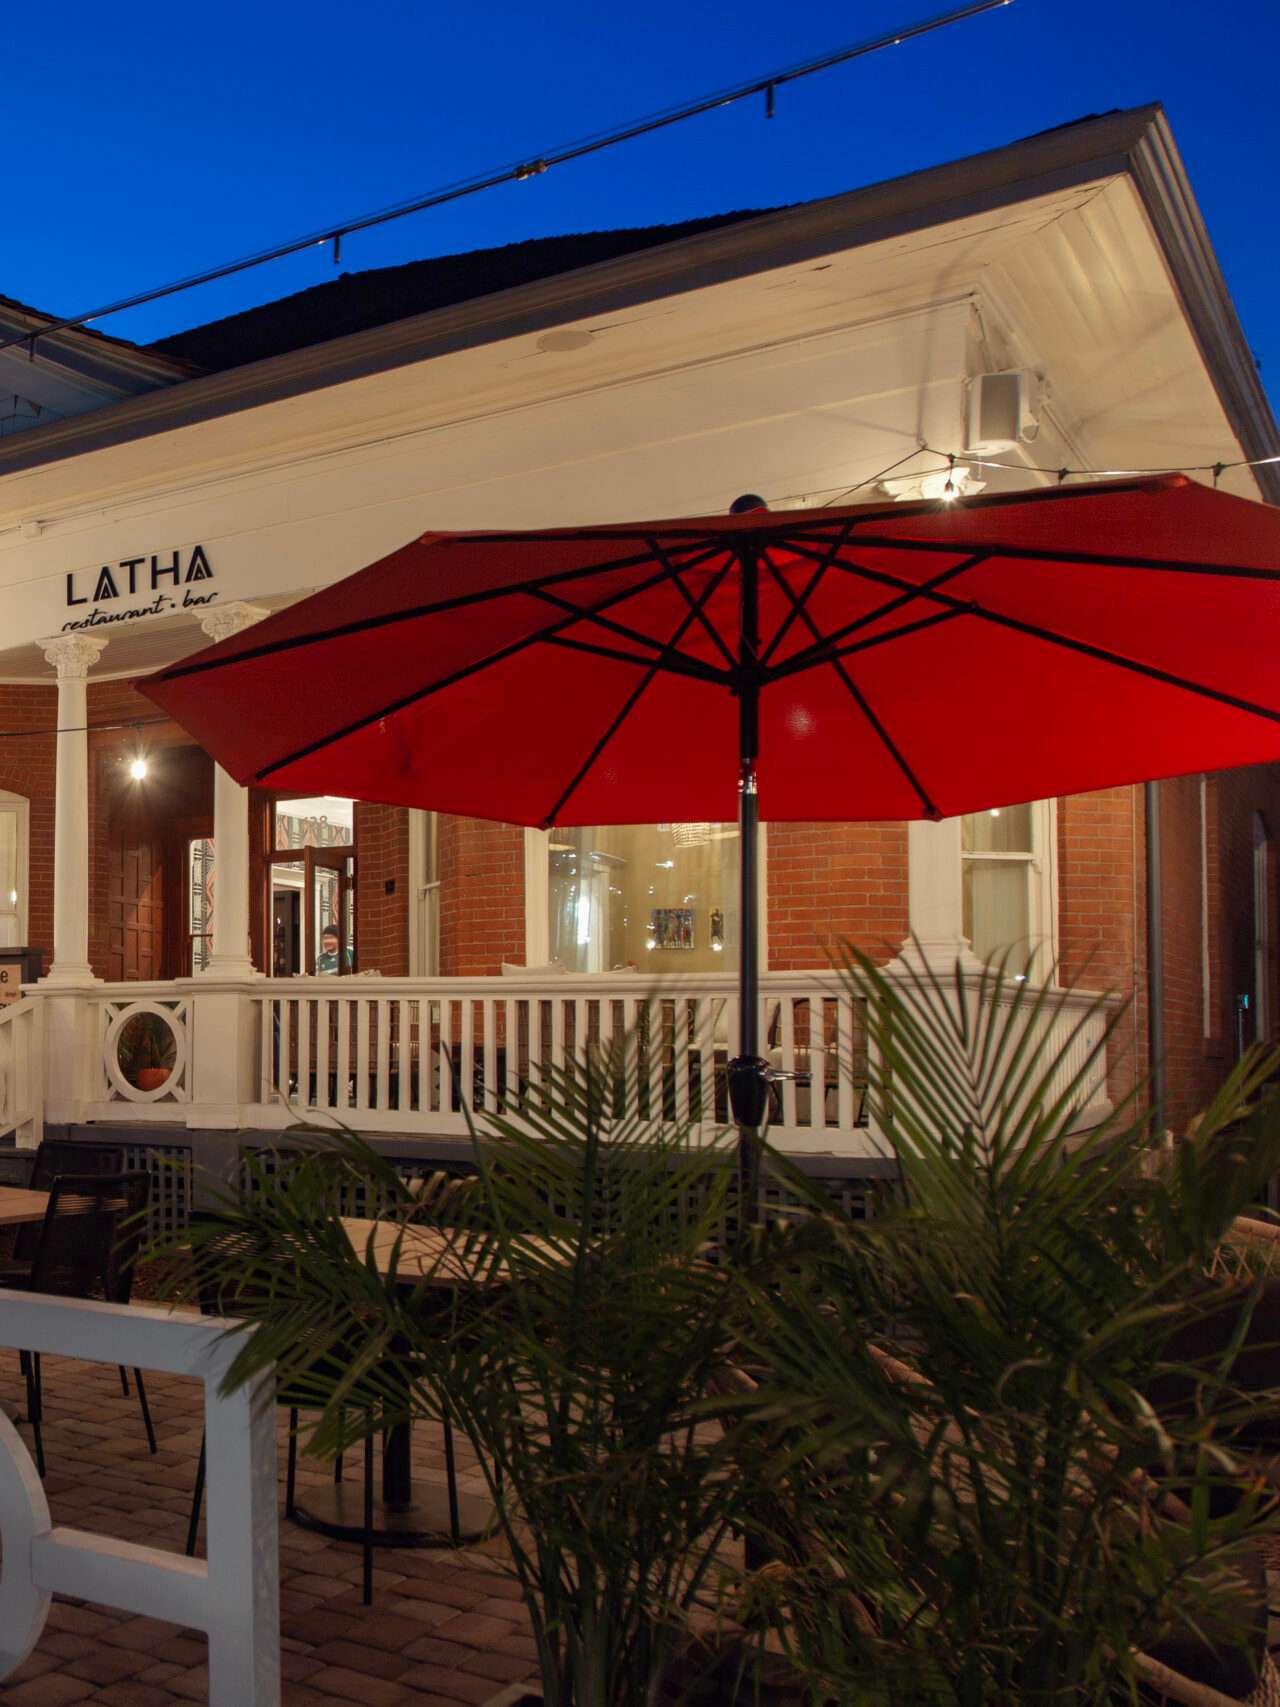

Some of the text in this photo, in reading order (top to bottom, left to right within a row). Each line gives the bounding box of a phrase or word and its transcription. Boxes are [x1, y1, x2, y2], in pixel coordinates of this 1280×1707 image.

[66, 544, 214, 606] LATHA
[61, 589, 218, 632] restaurant bar
